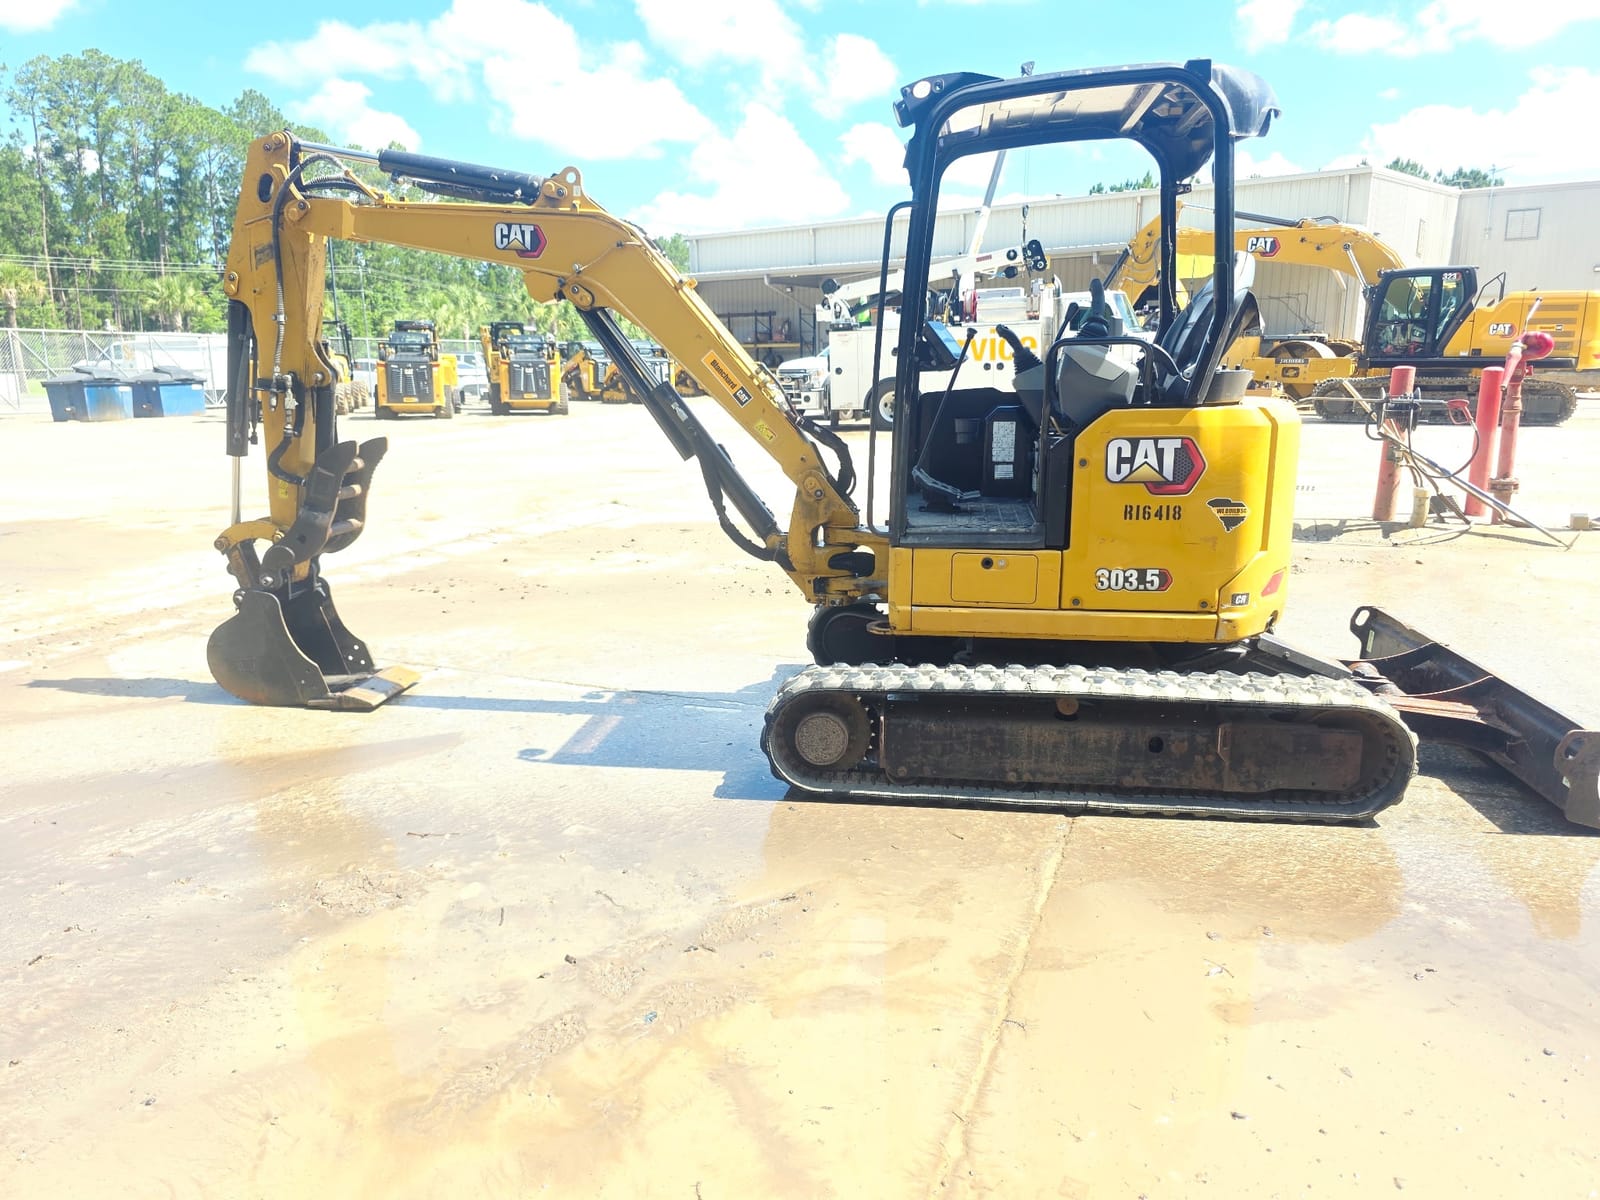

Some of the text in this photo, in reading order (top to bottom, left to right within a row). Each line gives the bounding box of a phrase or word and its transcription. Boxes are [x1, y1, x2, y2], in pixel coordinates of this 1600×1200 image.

[495, 223, 534, 250] CAT
[1247, 236, 1274, 253] CAT
[1489, 323, 1512, 336] CAT
[710, 359, 749, 403] Blanchard CAT
[1107, 438, 1183, 482] CAT
[1123, 504, 1183, 521] R16418
[1095, 568, 1160, 591] 303.5
[1234, 594, 1247, 605] CR
